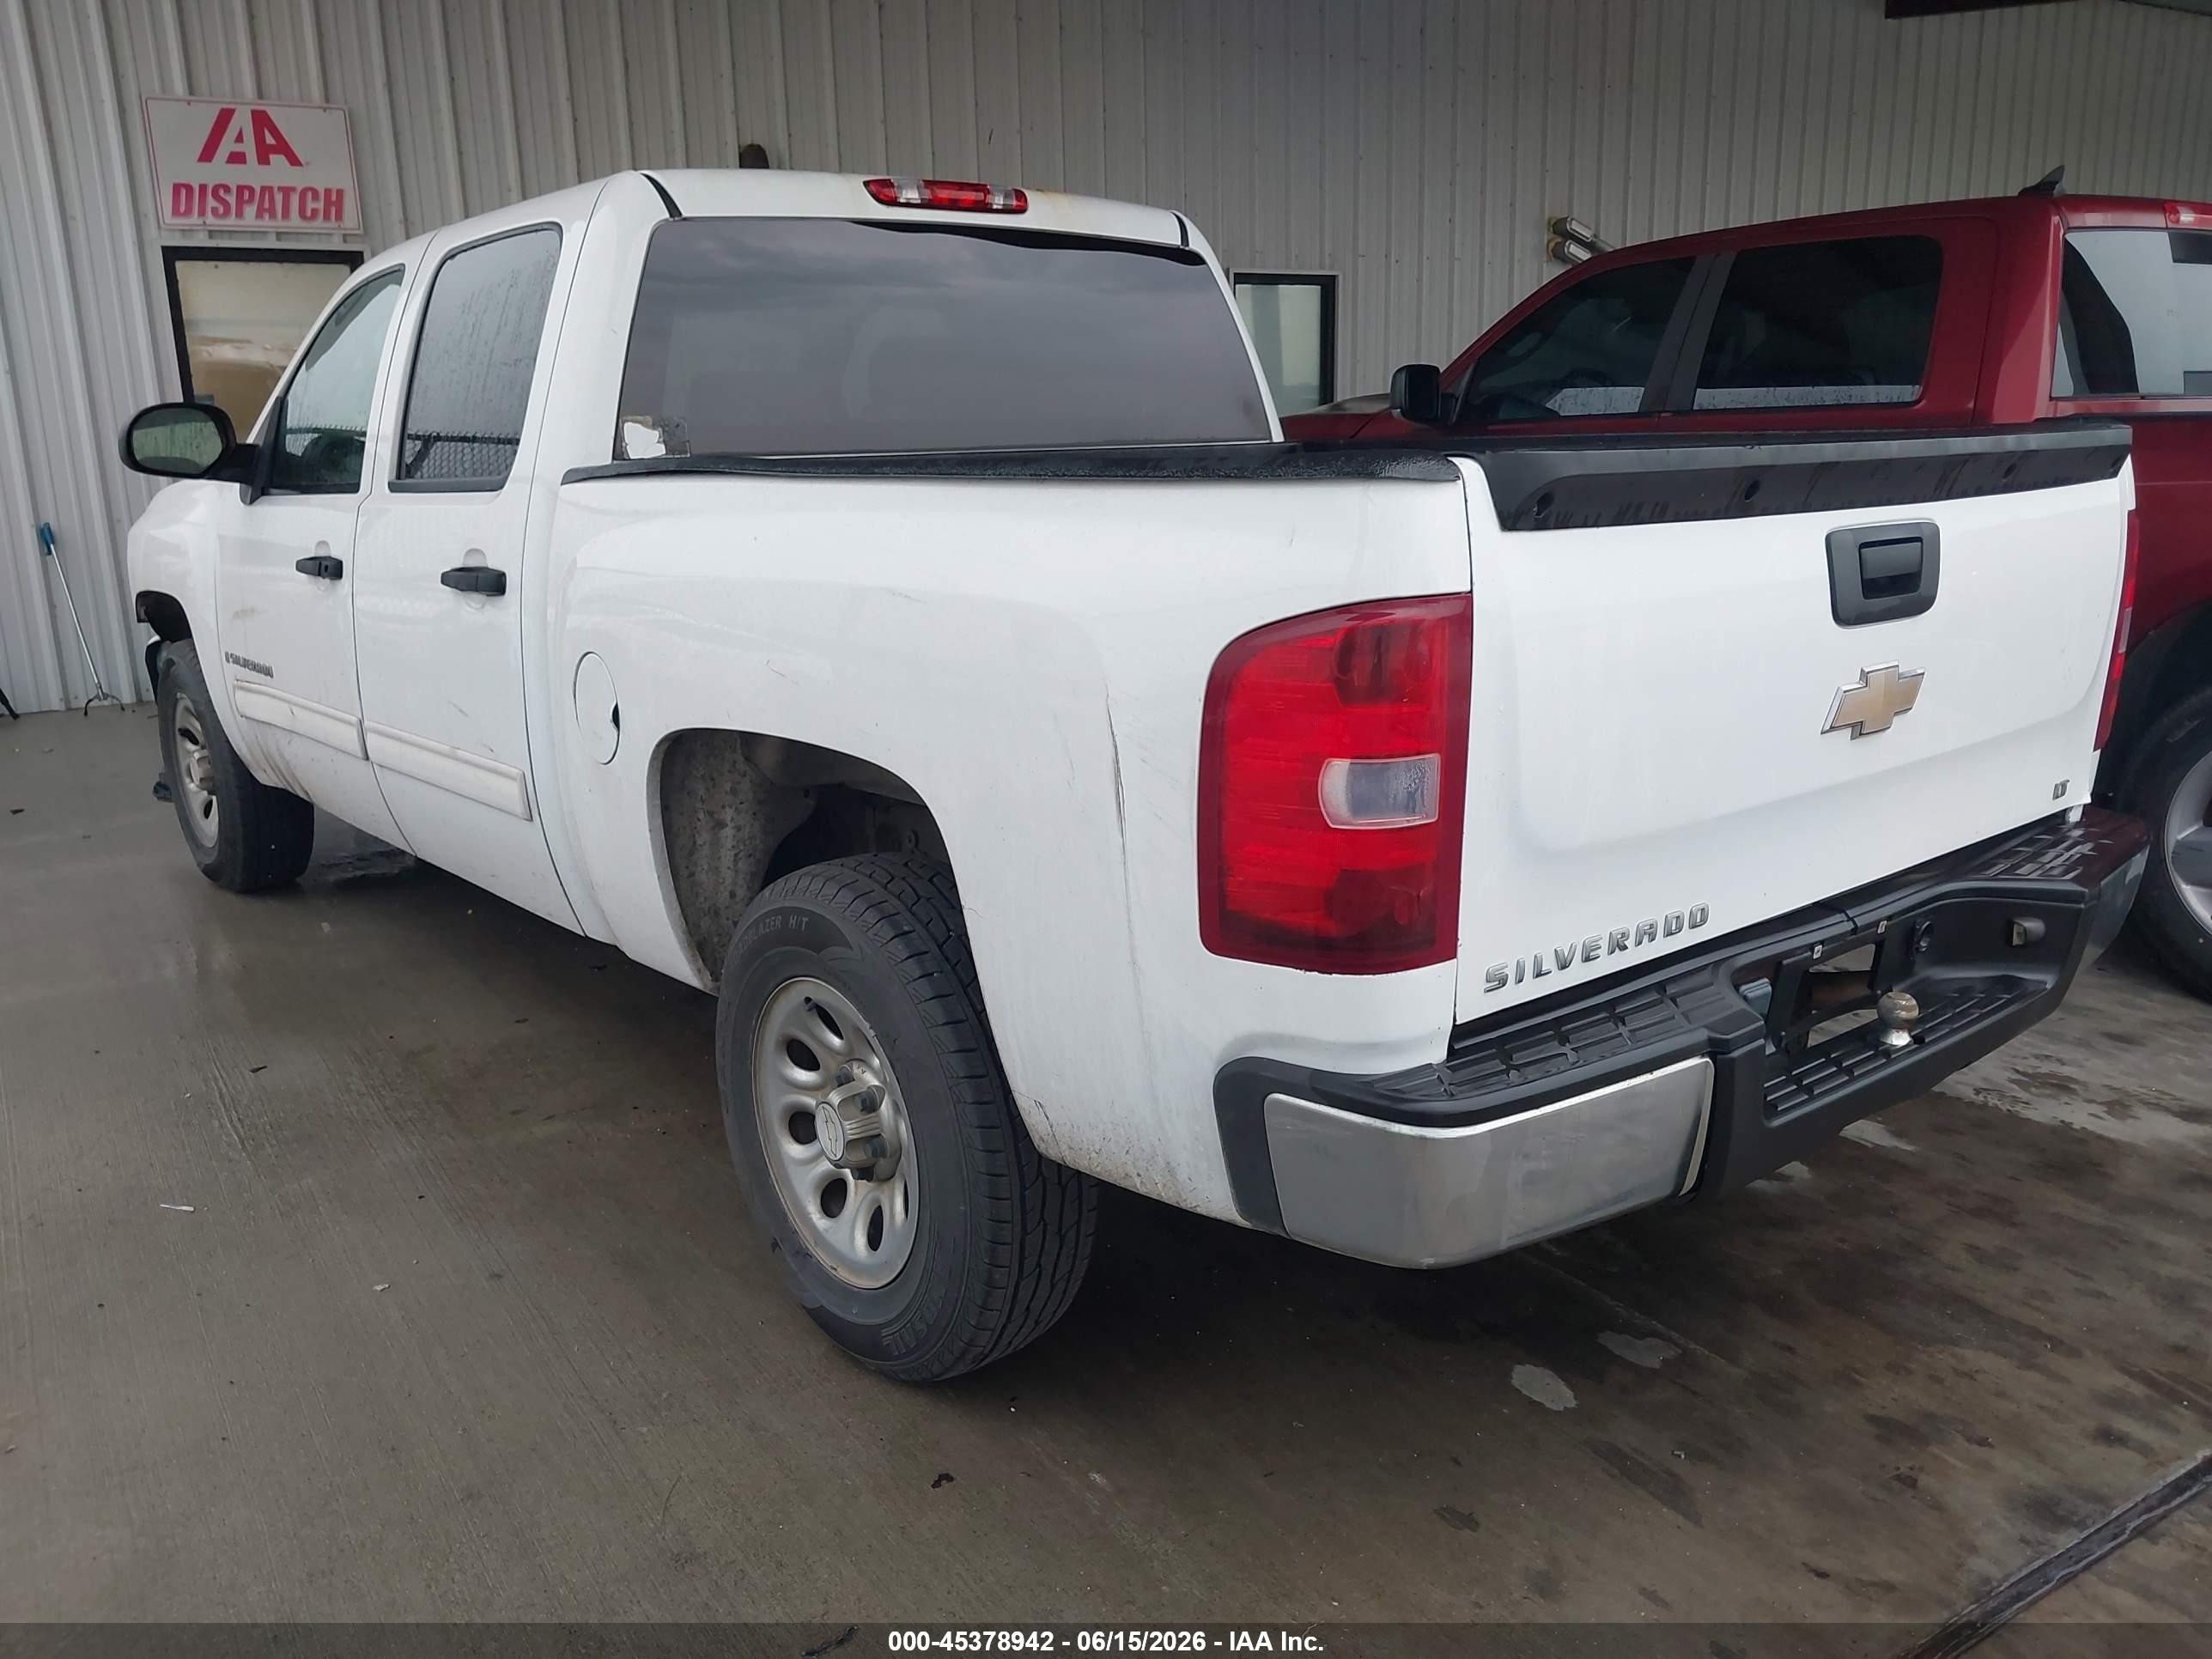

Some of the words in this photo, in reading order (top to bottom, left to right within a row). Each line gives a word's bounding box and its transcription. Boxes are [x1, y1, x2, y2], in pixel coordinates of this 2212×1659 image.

[172, 183, 344, 222] DISPATCH
[788, 914, 809, 932] H/T
[1484, 902, 1710, 994] SILVERADO
